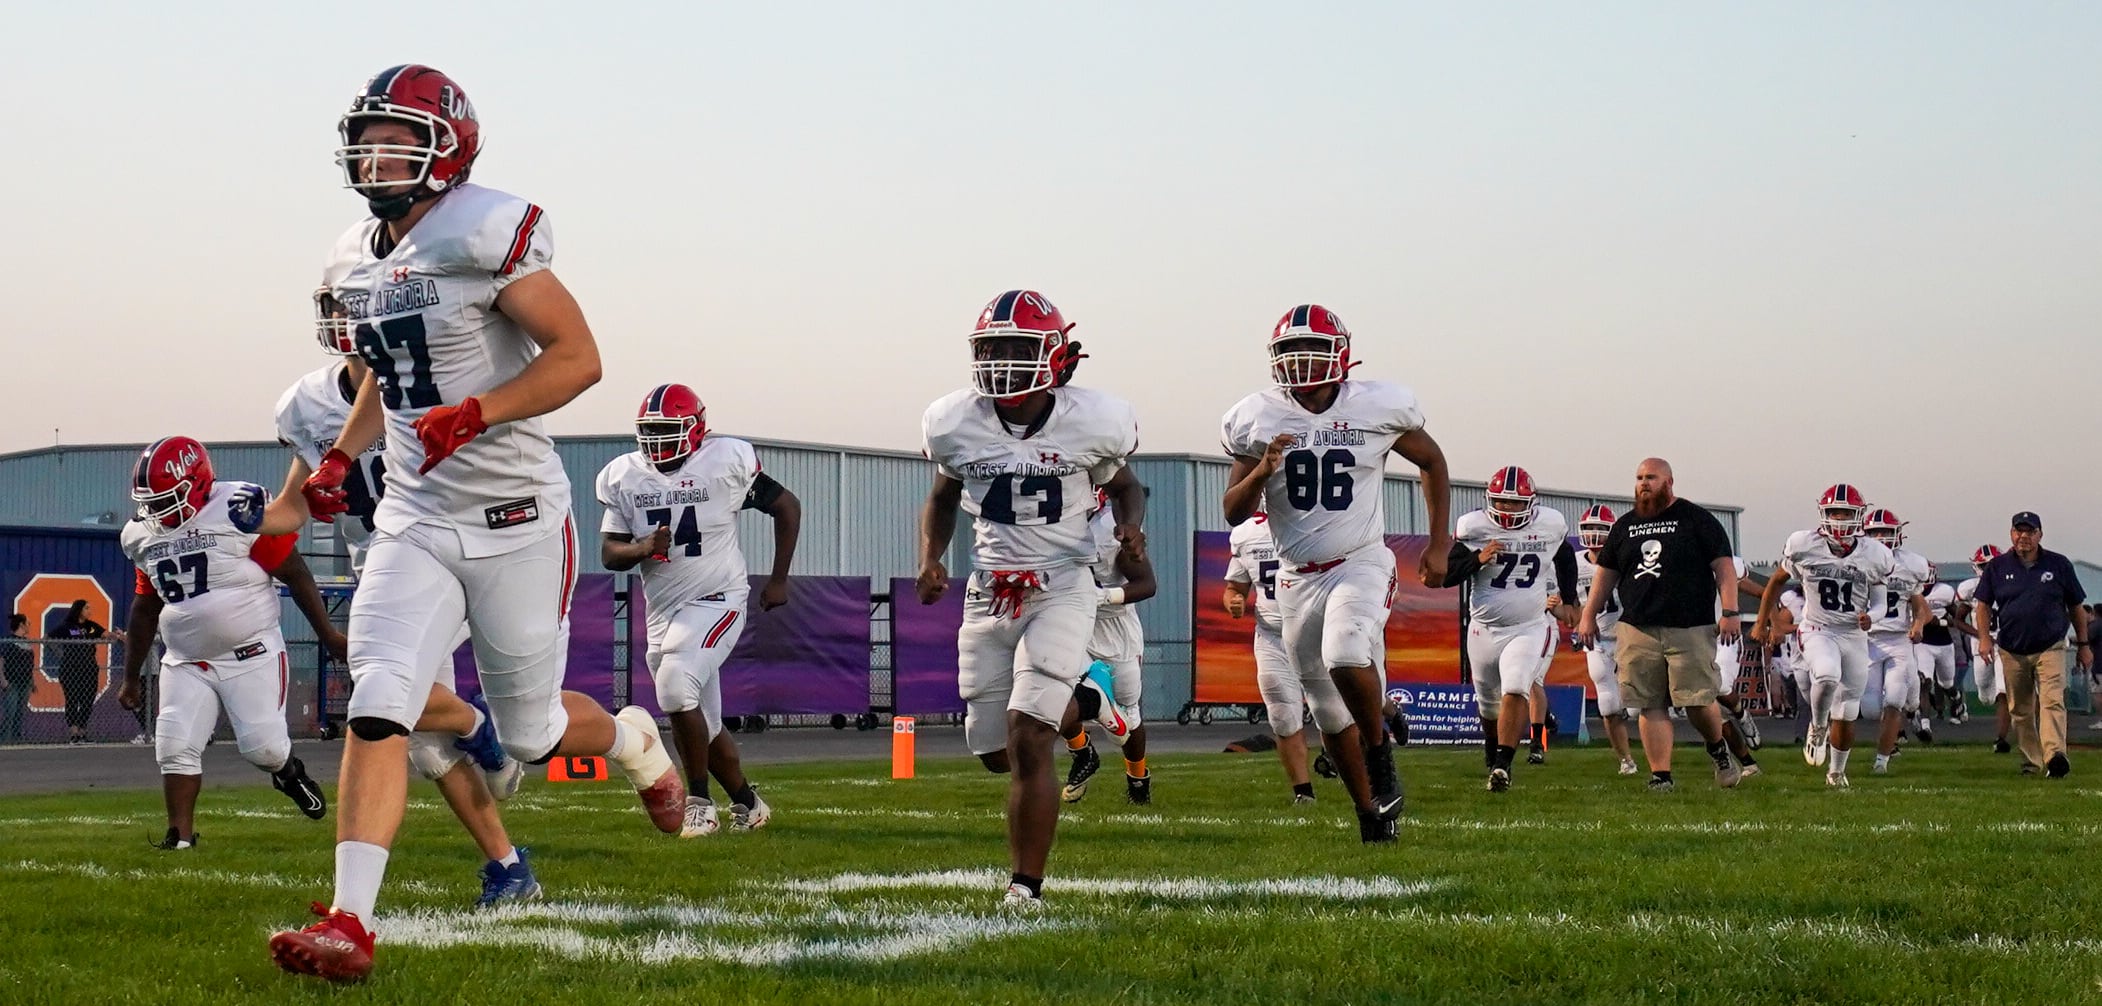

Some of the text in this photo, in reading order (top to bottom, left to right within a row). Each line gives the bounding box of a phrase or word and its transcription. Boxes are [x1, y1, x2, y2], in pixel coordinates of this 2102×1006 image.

[374, 280, 440, 317] AURORA
[355, 313, 443, 410] 97
[1313, 430, 1366, 446] AURORA
[165, 444, 199, 480] West
[966, 462, 1008, 480] WEST
[1285, 449, 1356, 511] 86
[633, 487, 710, 508] WEST AURORA
[981, 472, 1063, 525] 43
[646, 505, 702, 557] 74
[1628, 520, 1679, 531] BLACKHAWK
[1629, 526, 1676, 538] LINEMEN
[157, 551, 210, 604] 67
[1490, 553, 1541, 589] 73
[1818, 579, 1855, 612] 81
[13, 572, 113, 713] O
[1417, 702, 1466, 710] INSURANCE
[1418, 691, 1479, 703] FARMER
[1432, 713, 1447, 723] for
[1447, 714, 1481, 725] helping
[565, 756, 597, 779] G
